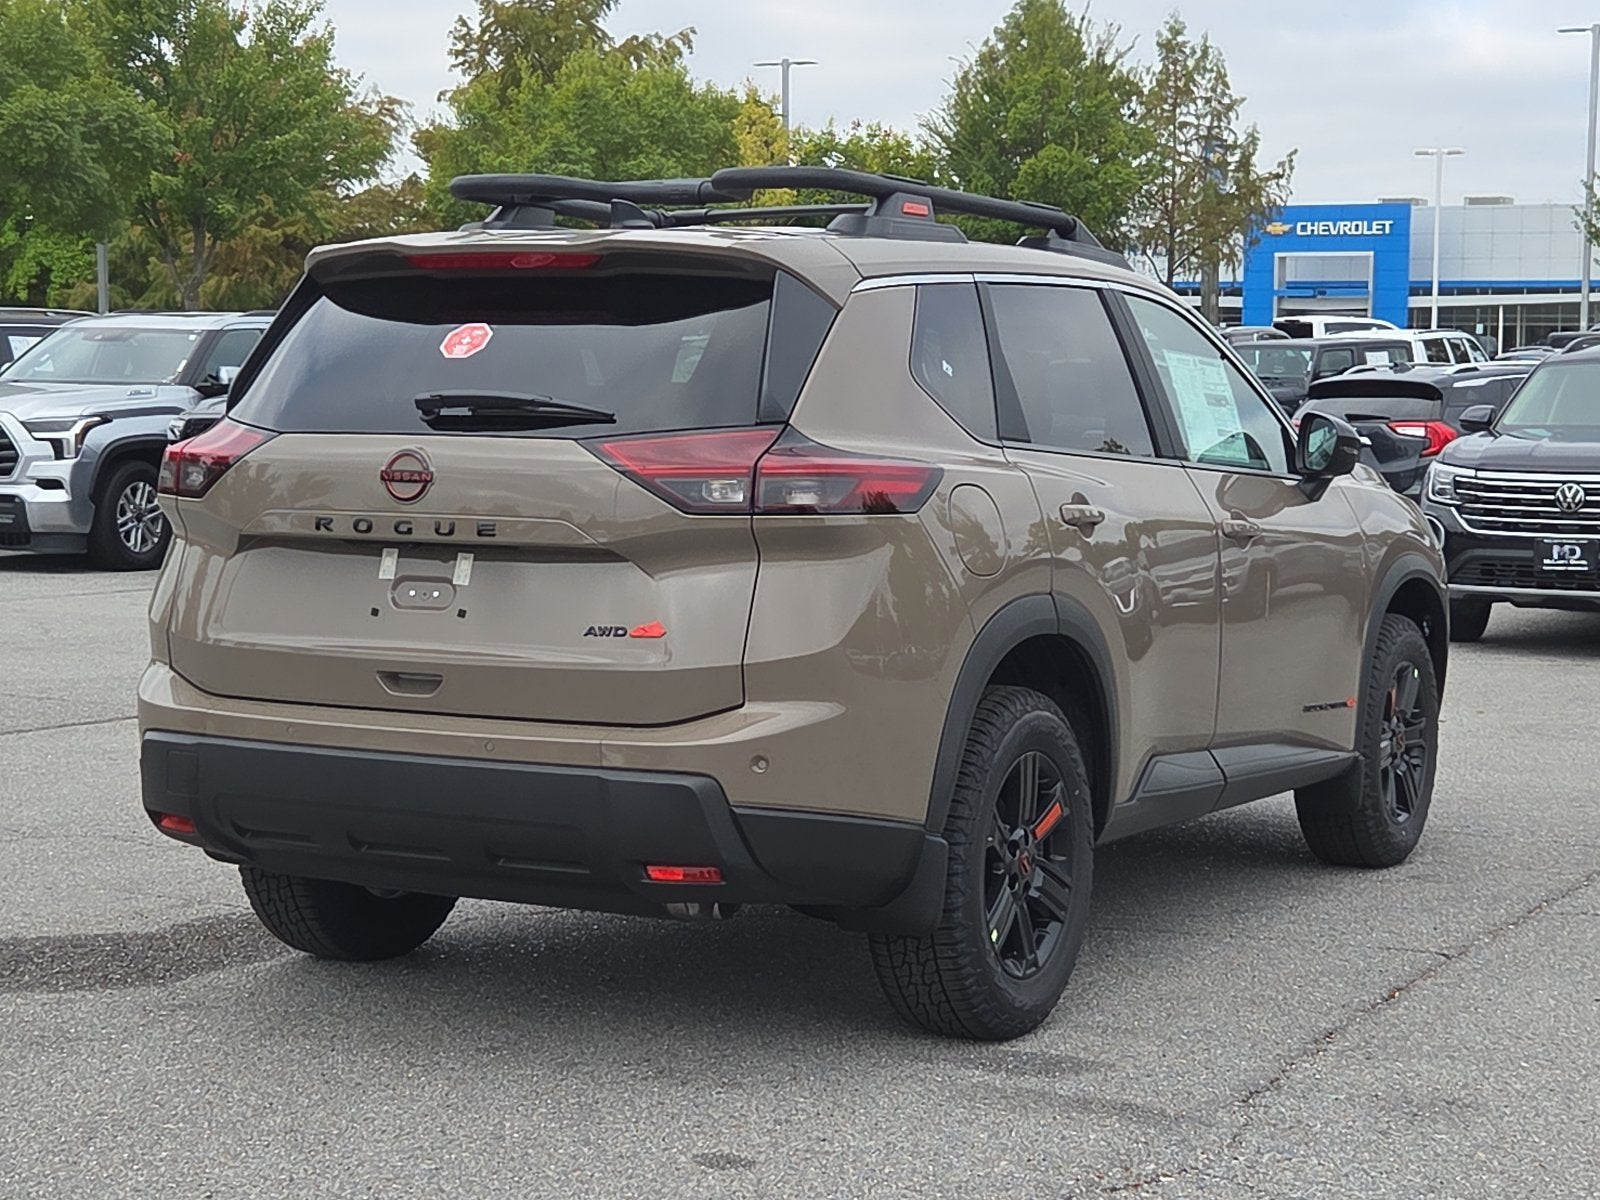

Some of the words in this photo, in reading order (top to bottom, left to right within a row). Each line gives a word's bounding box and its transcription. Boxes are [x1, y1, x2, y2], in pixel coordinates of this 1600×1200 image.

[1296, 220, 1394, 236] CHEVROLET
[381, 471, 432, 481] NISSAN
[314, 516, 497, 538] ROGUE
[583, 625, 628, 638] AWD
